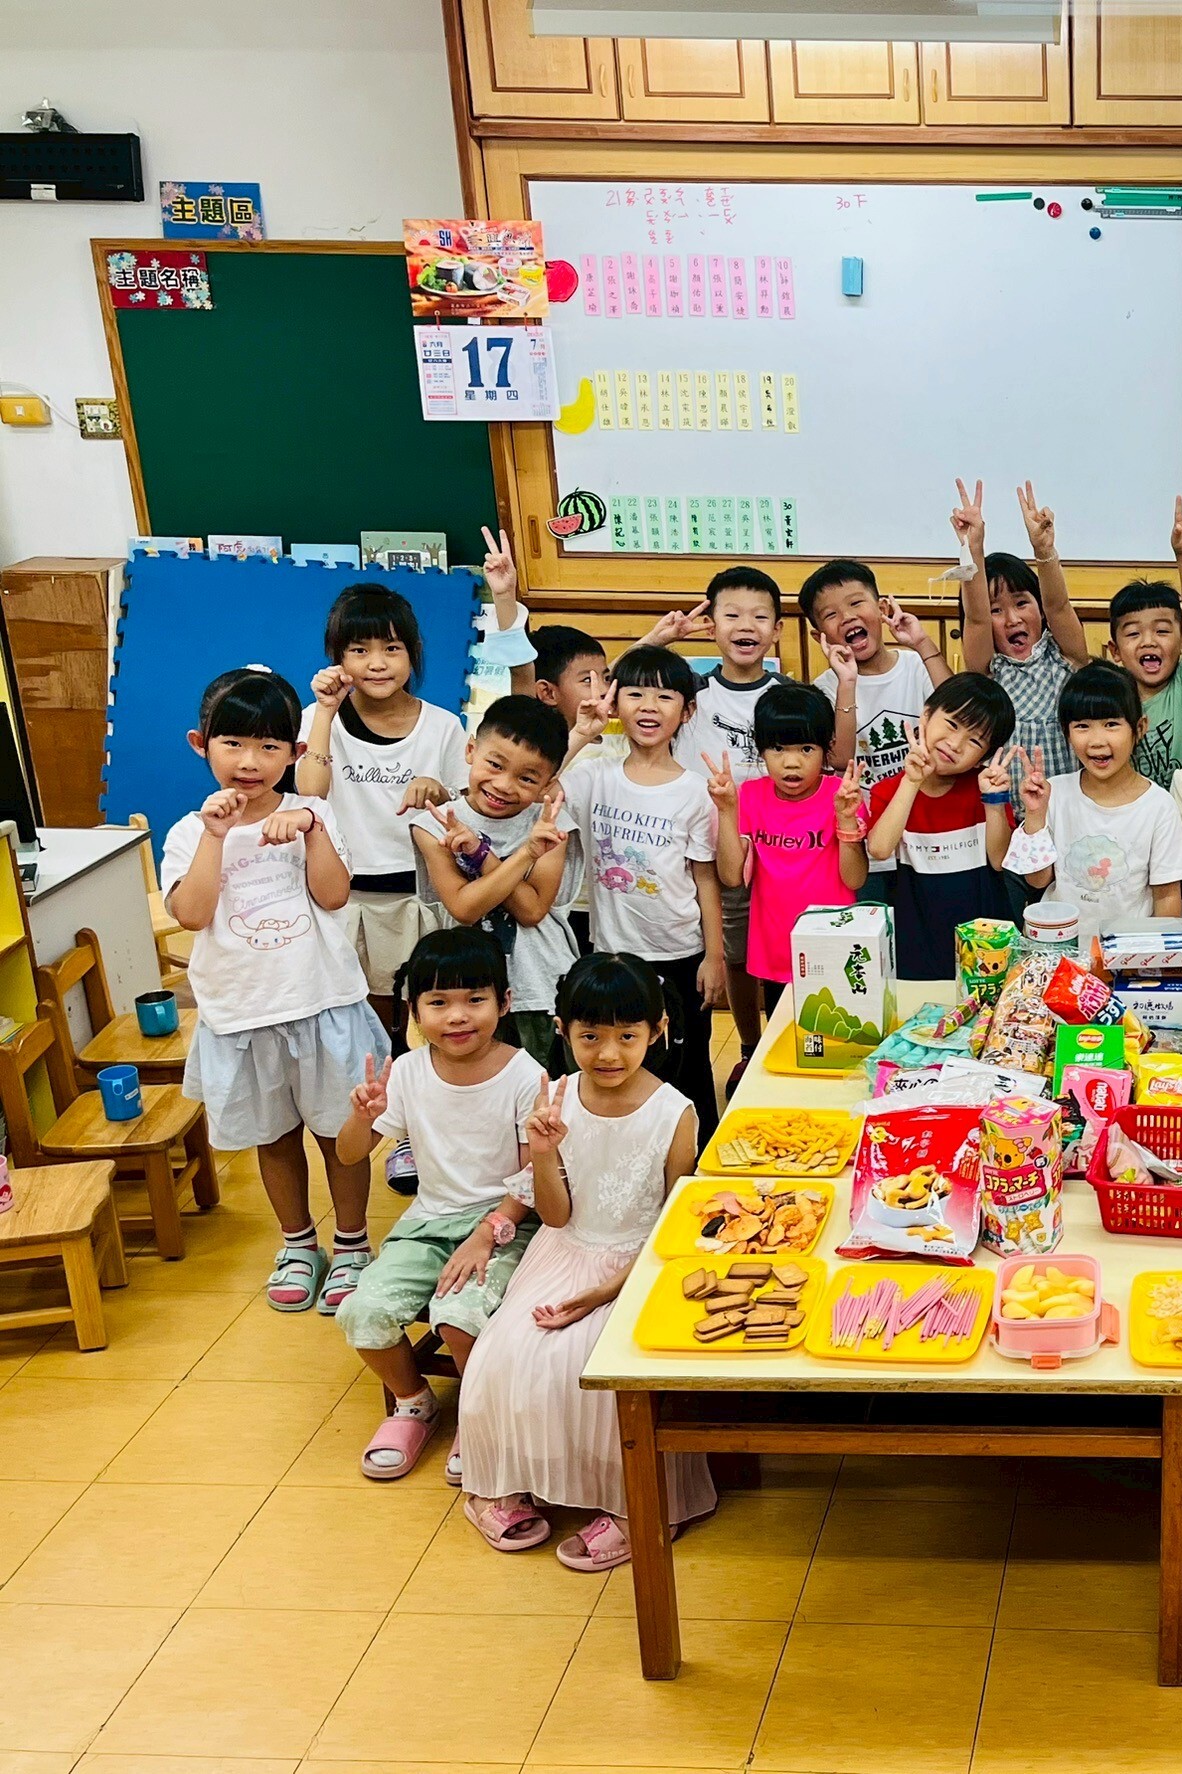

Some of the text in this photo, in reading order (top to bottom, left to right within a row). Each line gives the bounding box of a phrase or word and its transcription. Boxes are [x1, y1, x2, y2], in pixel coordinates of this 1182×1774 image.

[172, 197, 253, 224] 主題區
[439, 229, 452, 247] SH
[116, 269, 200, 288] 主題名稱
[462, 337, 513, 388] 17
[465, 389, 519, 401] 星期四
[342, 764, 412, 784] Brilliant
[635, 812, 676, 831] KITTY
[613, 825, 673, 847] FRIENDS
[754, 829, 804, 848] Hurley
[232, 876, 273, 890] WONDER
[985, 1170, 1039, 1193] コアラのマーチ
